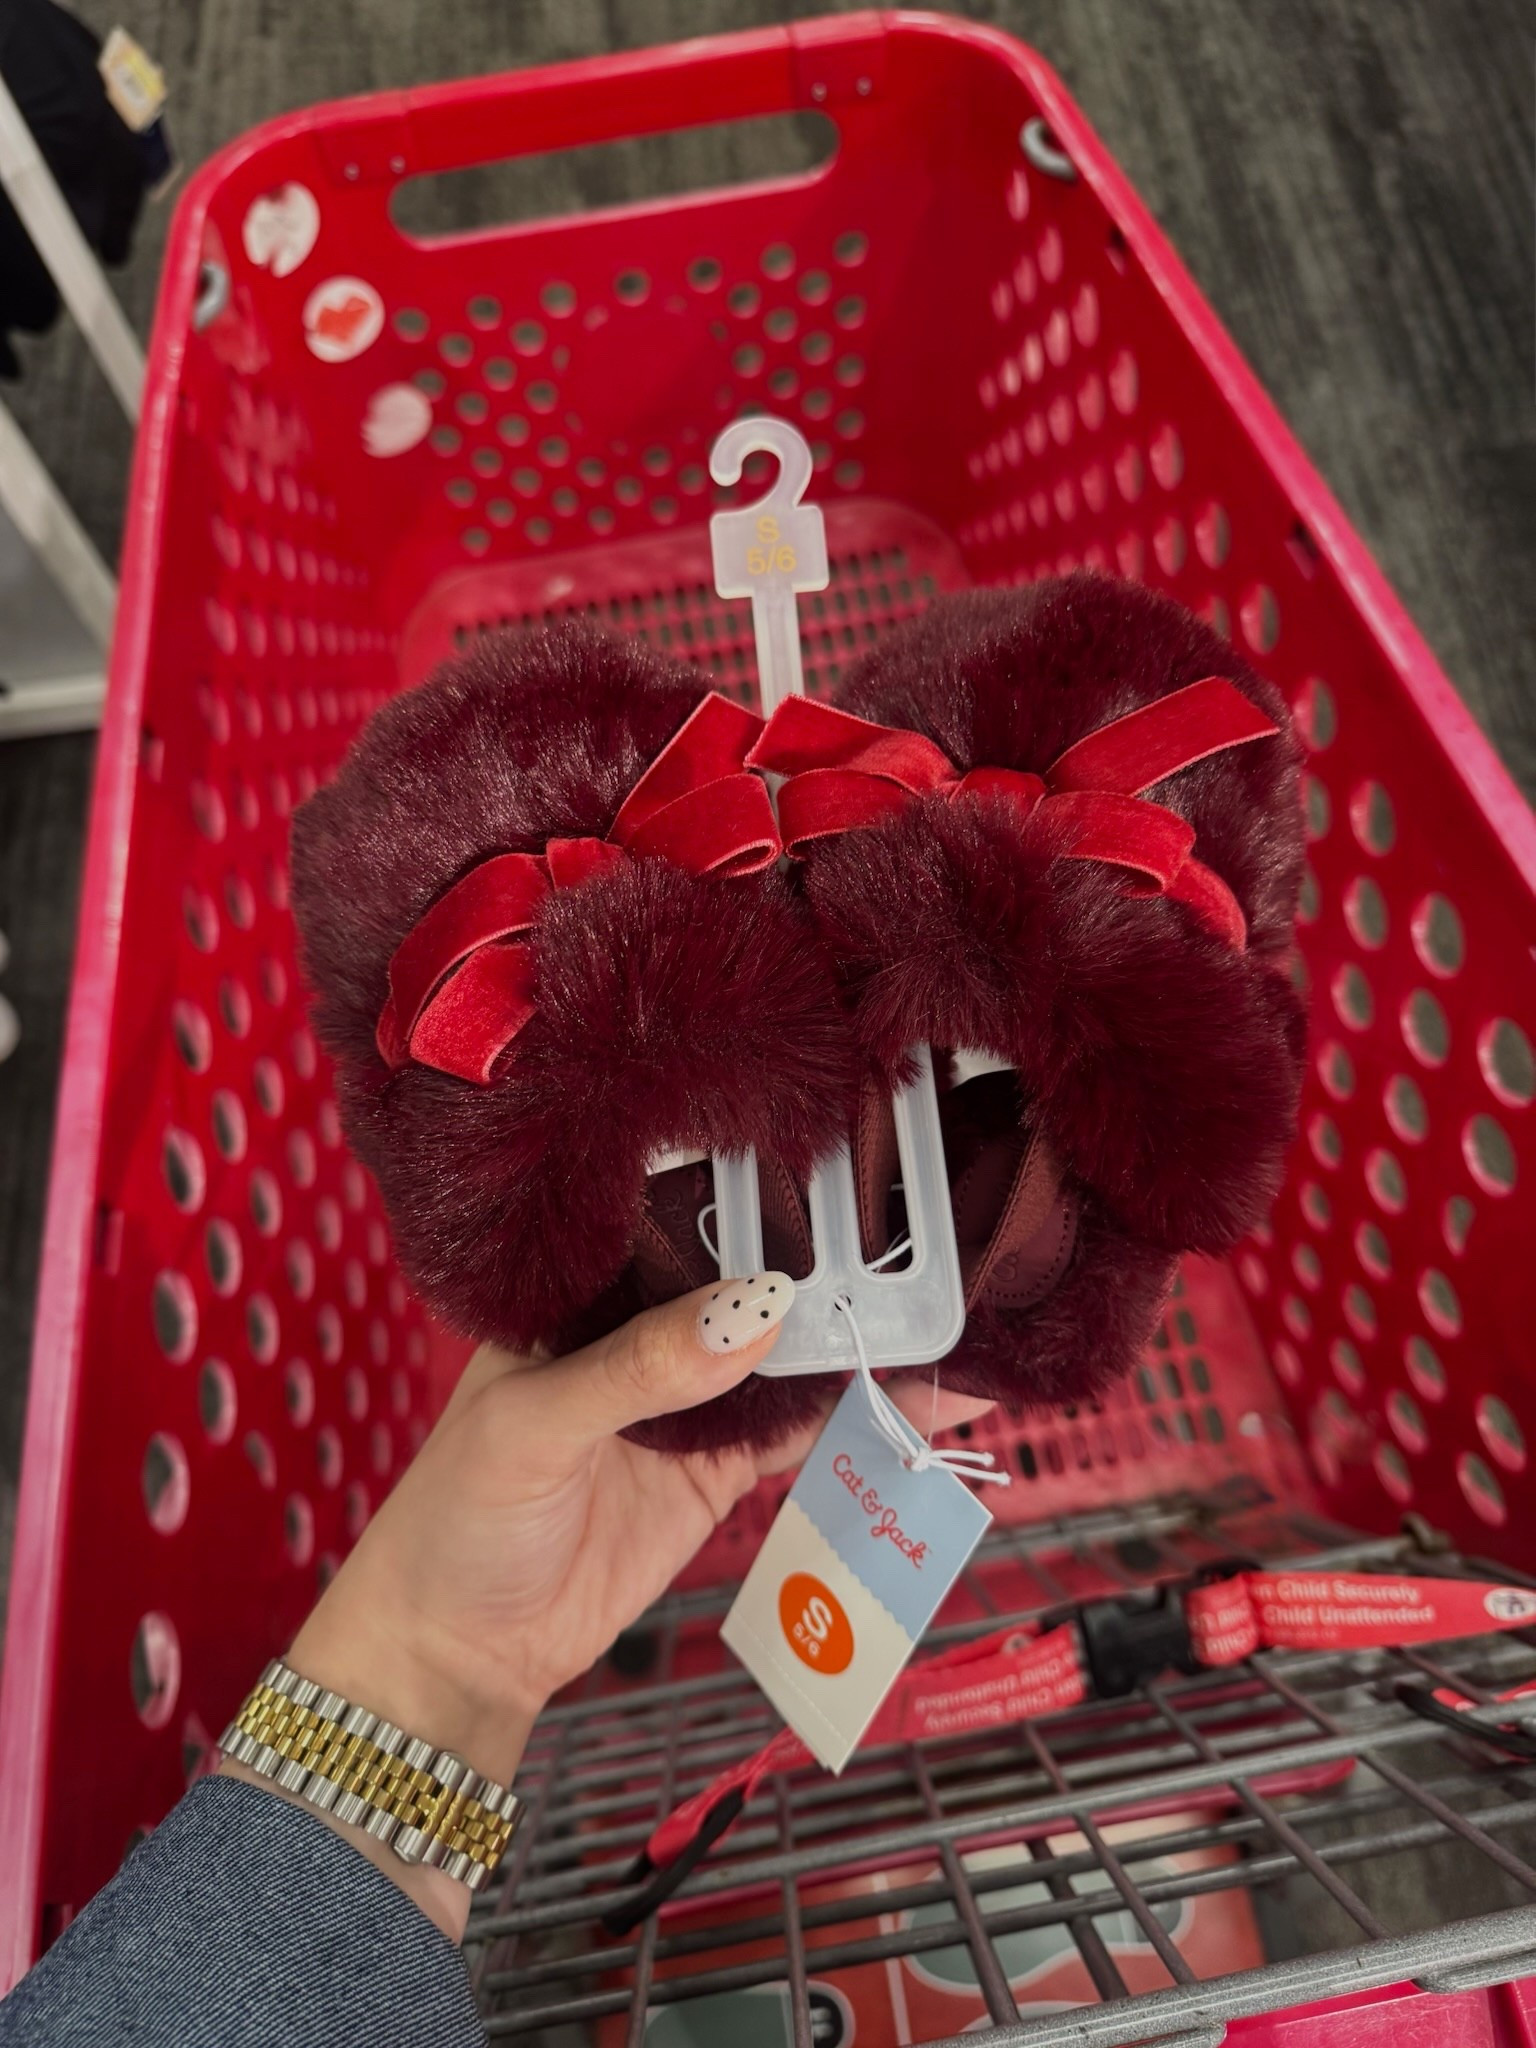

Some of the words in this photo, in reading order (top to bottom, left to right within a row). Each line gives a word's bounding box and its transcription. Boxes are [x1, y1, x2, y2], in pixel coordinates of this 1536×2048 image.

[757, 515, 780, 544] S
[747, 545, 797, 576] 5/6
[832, 1453, 864, 1497] Cat
[861, 1488, 884, 1514] &
[869, 1507, 927, 1570] Jack
[802, 1596, 832, 1640] S
